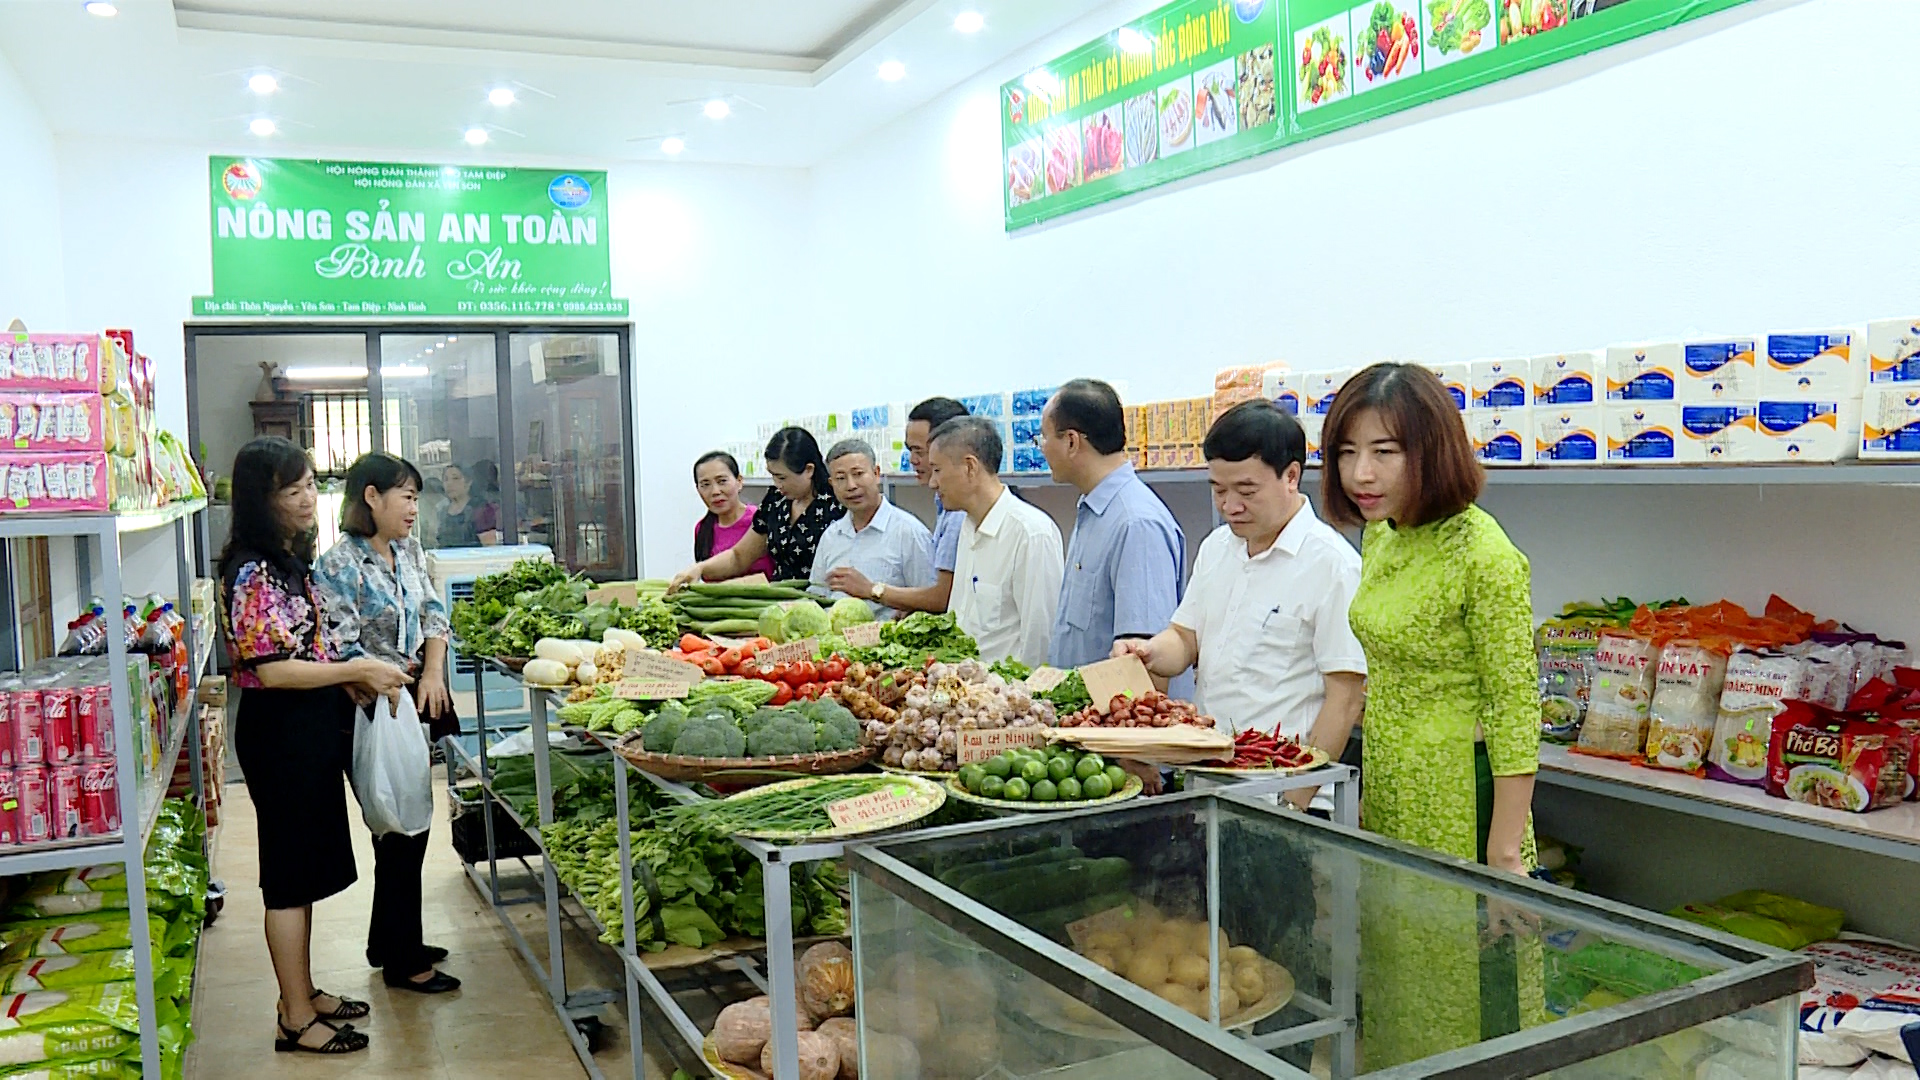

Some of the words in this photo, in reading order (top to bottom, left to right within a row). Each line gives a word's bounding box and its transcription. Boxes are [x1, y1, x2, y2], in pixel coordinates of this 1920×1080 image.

[326, 165, 345, 176] HỘI
[347, 165, 379, 177] NÔNG
[354, 177, 372, 188] HỘI
[374, 178, 402, 189] NÔNG
[217, 201, 332, 240] NÔNG
[345, 198, 426, 242] SẢN
[438, 213, 491, 244] AN
[502, 209, 597, 245] TOÀN
[314, 243, 426, 279] Bình
[447, 246, 522, 280] An
[1786, 731, 1814, 752] Phở
[1814, 737, 1840, 756] Bò
